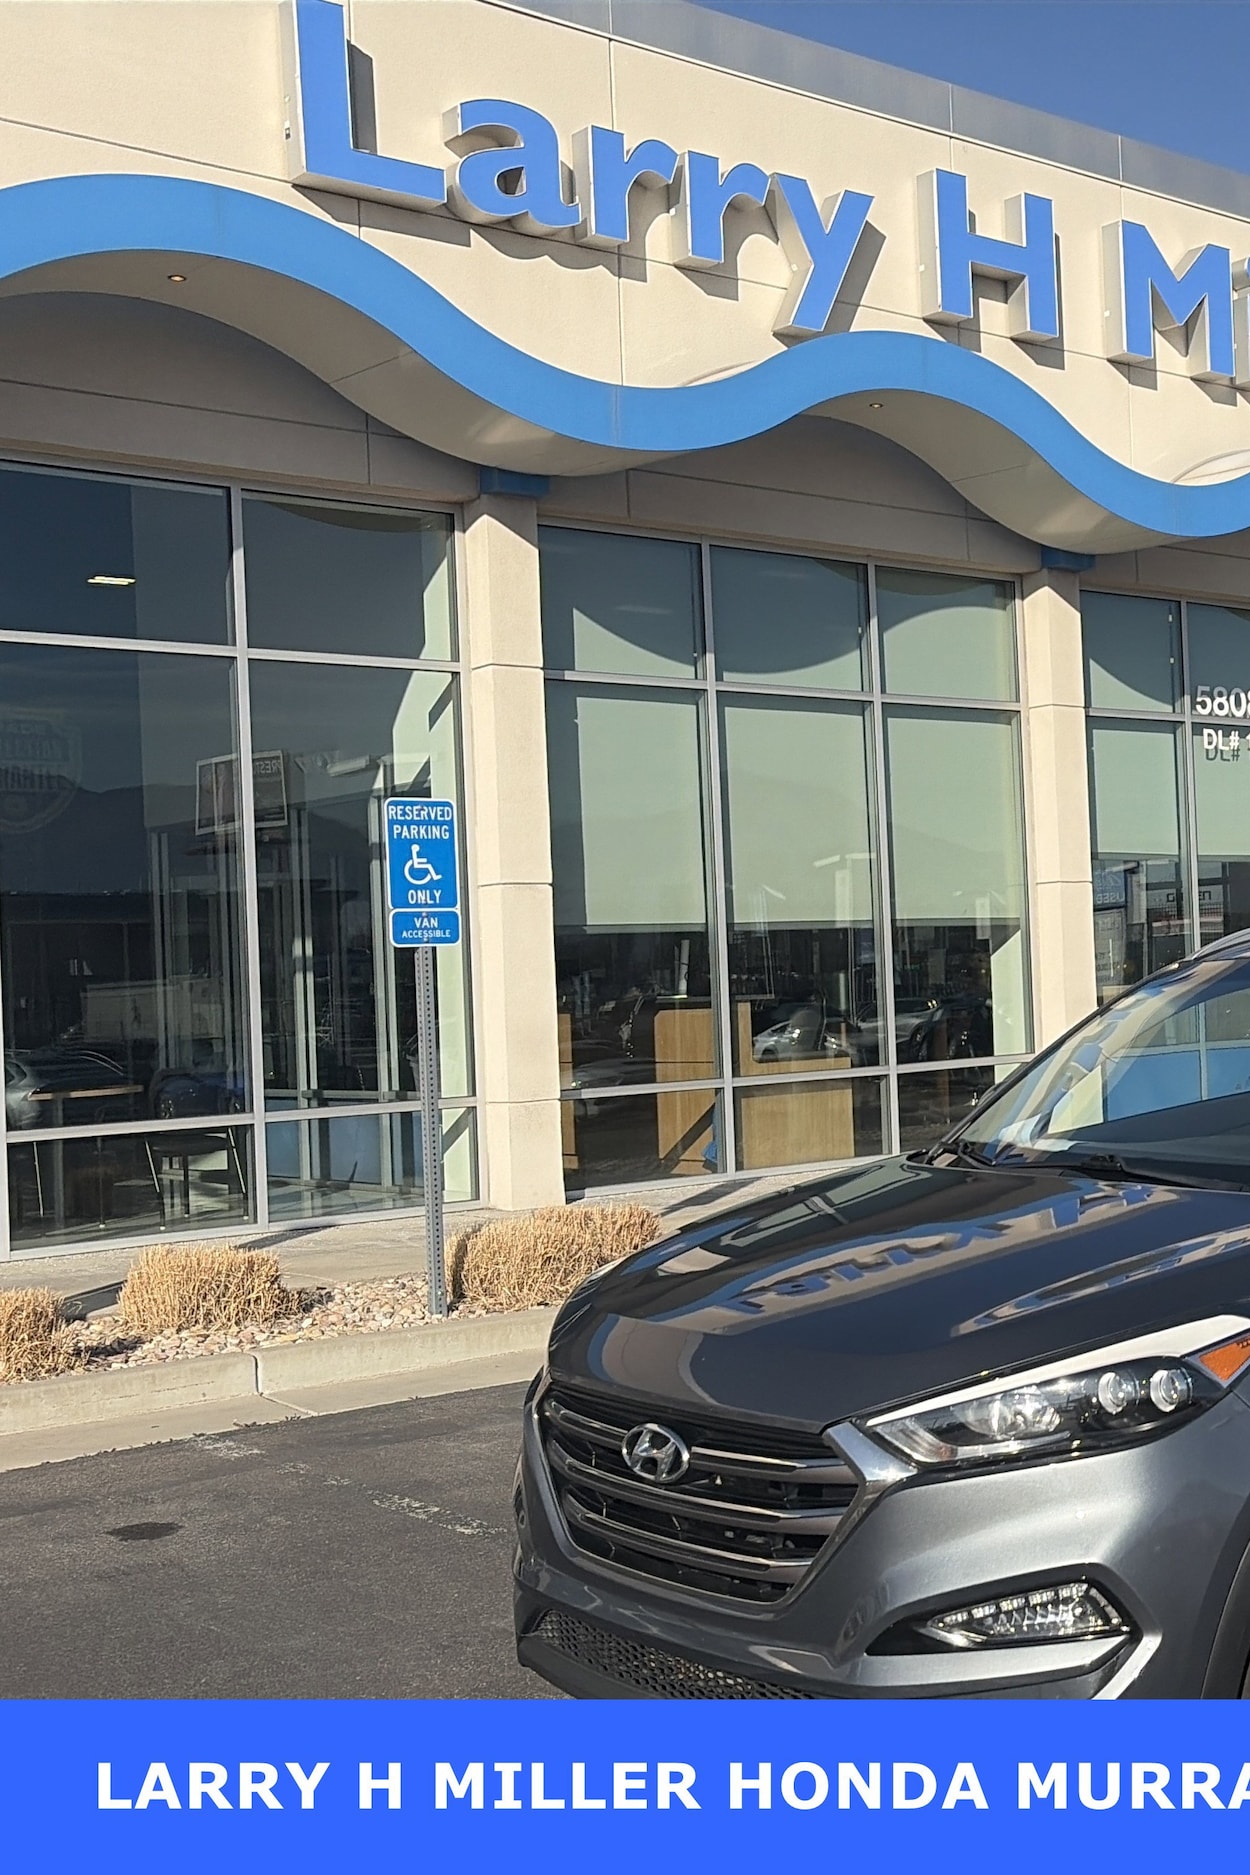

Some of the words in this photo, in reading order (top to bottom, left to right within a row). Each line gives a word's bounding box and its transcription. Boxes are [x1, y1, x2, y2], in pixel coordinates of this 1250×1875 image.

[284, 0, 875, 333] Larry
[918, 167, 1059, 342] H
[1203, 727, 1240, 751] DL#
[388, 805, 453, 821] RESERVED
[393, 824, 450, 840] PARKING
[408, 889, 442, 905] ONLY
[414, 917, 439, 929] VAN
[401, 929, 452, 939] ACCESSIBLE
